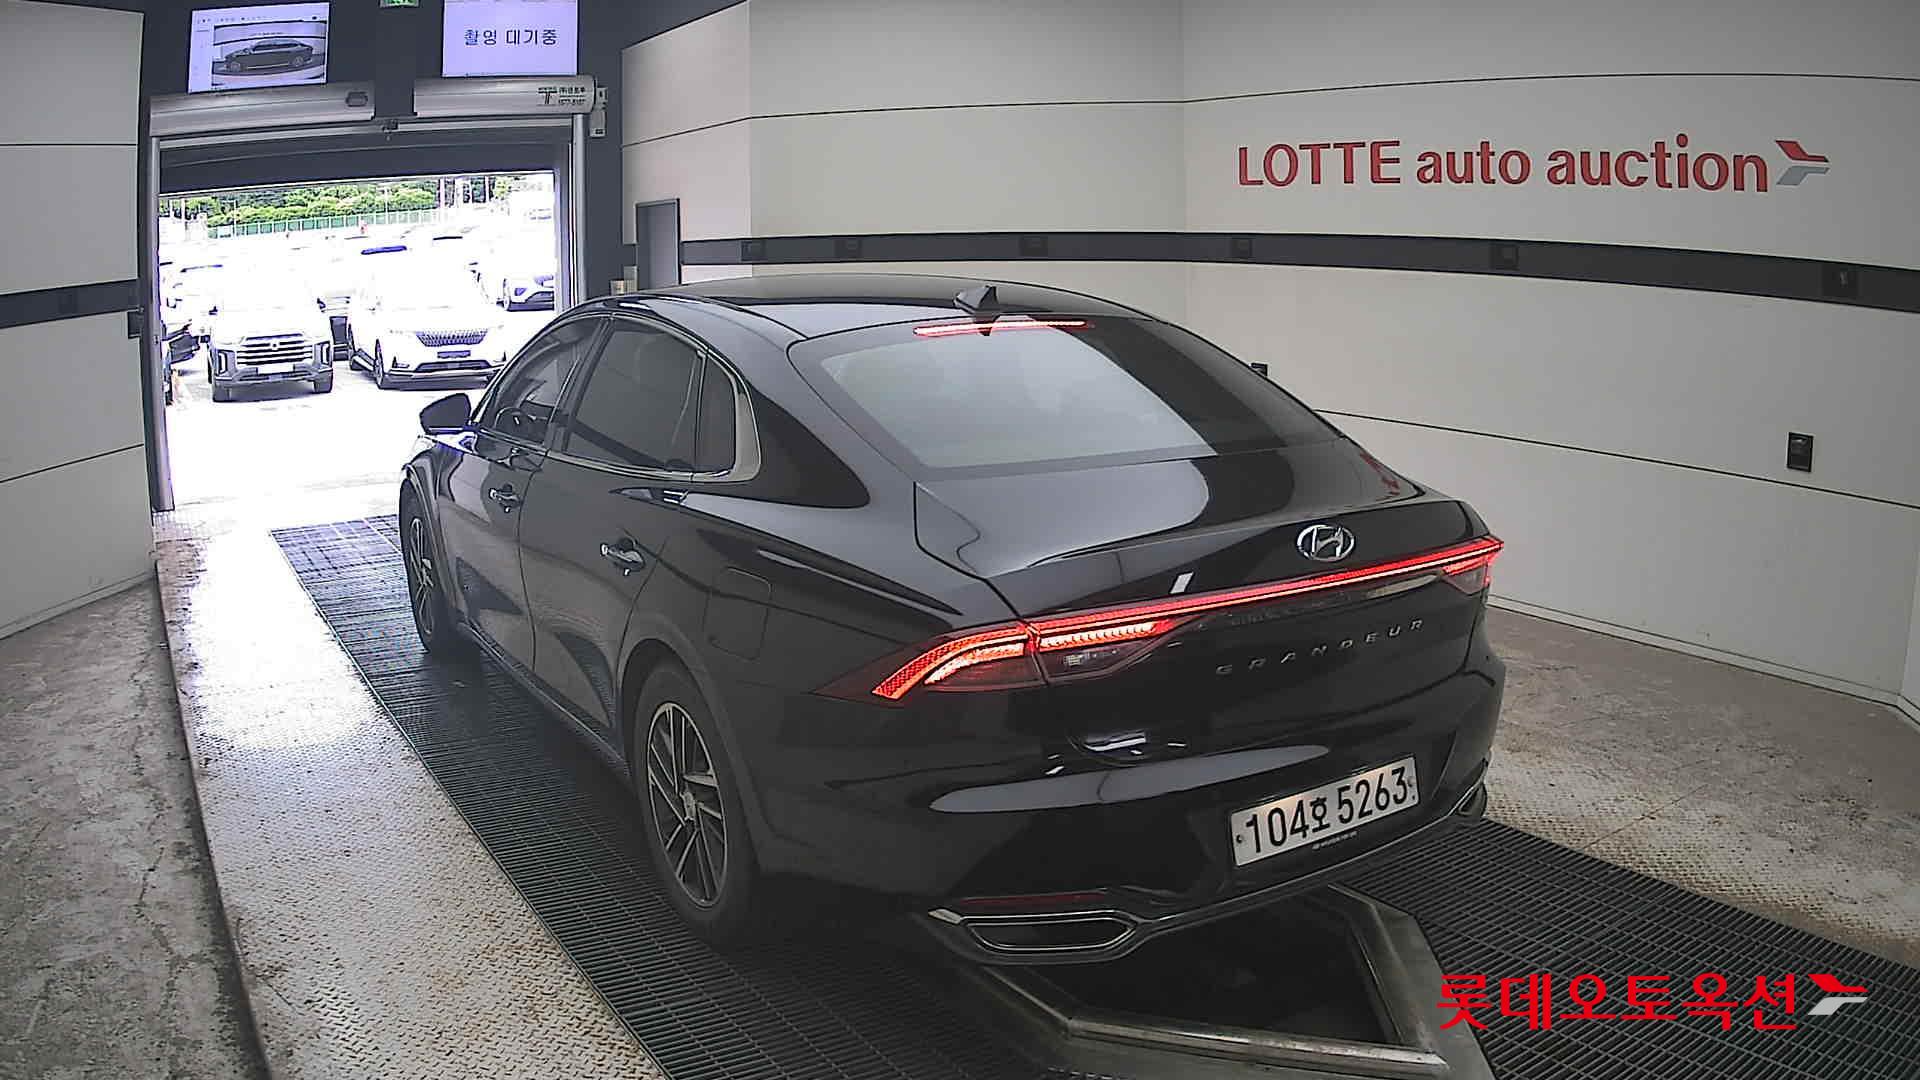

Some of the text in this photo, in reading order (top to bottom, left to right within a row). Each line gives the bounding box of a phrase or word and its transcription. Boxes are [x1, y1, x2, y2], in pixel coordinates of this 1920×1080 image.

[464, 29, 557, 46] 촬영 대기중
[1238, 133, 1769, 192] LOTTE auto auction
[1216, 619, 1422, 674] GRANDEUR
[1337, 766, 1408, 825] 5263
